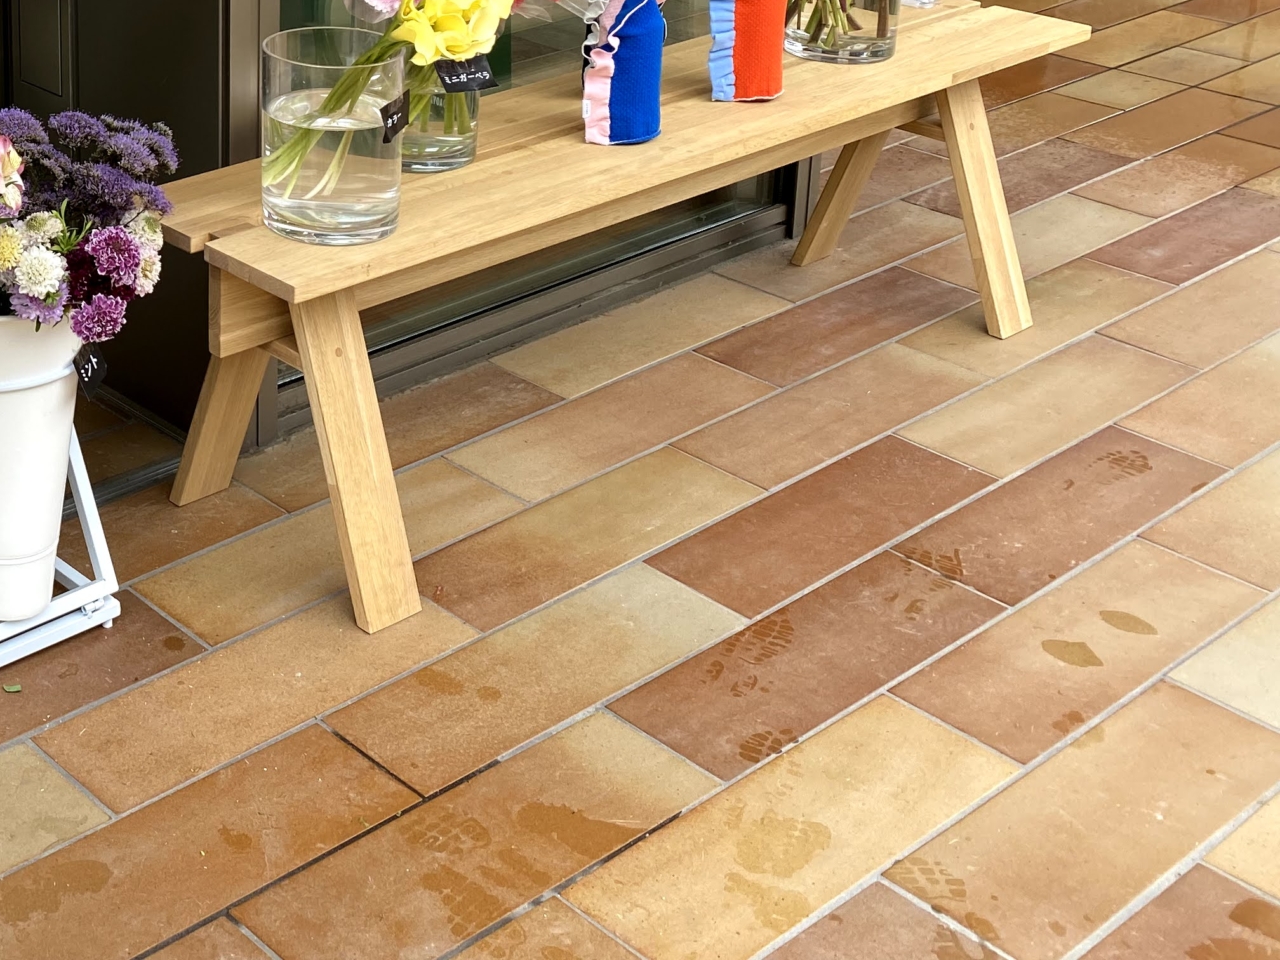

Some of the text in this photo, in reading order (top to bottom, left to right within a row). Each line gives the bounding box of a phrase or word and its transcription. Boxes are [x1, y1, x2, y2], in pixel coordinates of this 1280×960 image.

[444, 71, 490, 84] ミニガーベラ
